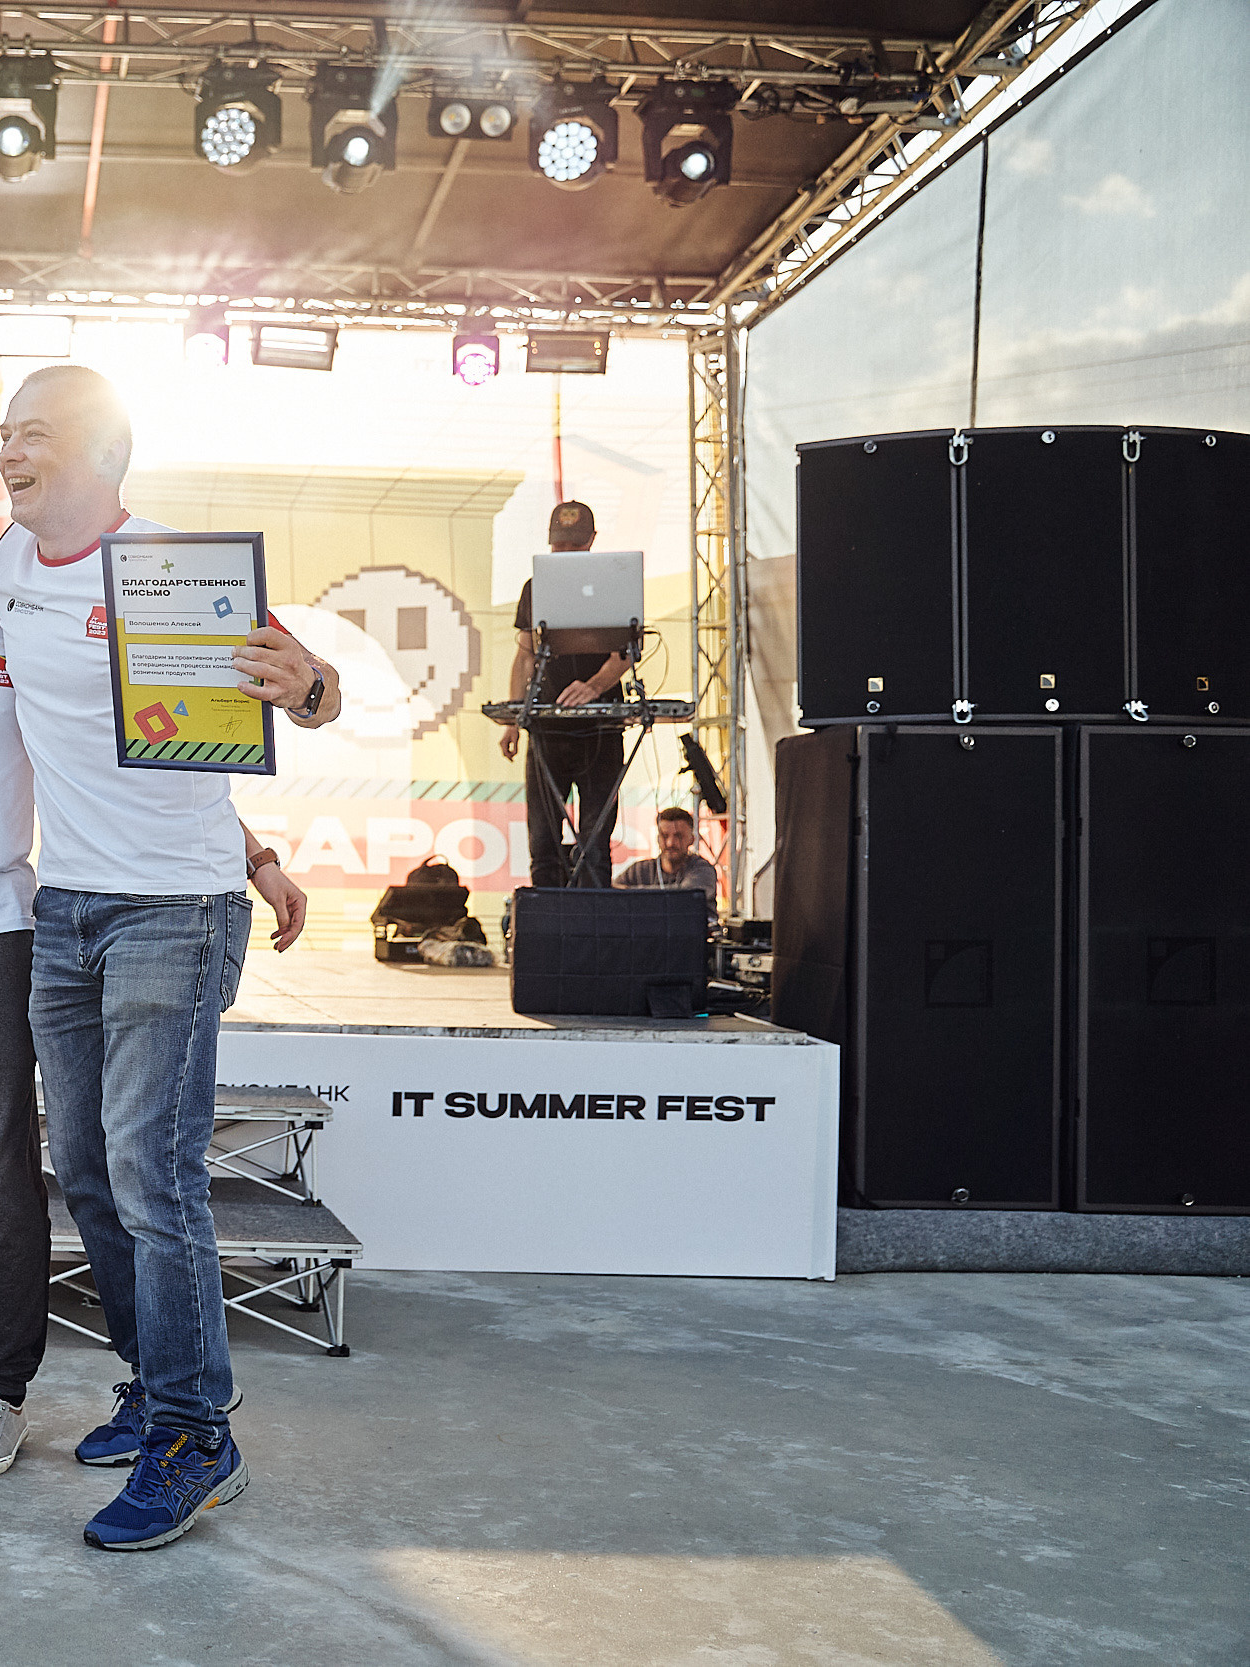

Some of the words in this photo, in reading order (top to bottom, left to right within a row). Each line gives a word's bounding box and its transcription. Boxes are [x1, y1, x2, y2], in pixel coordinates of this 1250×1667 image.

[121, 579, 247, 587] БЛАГОДАРСТВЕННОЕ
[122, 589, 171, 597] ПИСЬМО
[392, 1091, 434, 1117] IT
[444, 1091, 646, 1120] SUMMER
[657, 1095, 776, 1122] FEST
